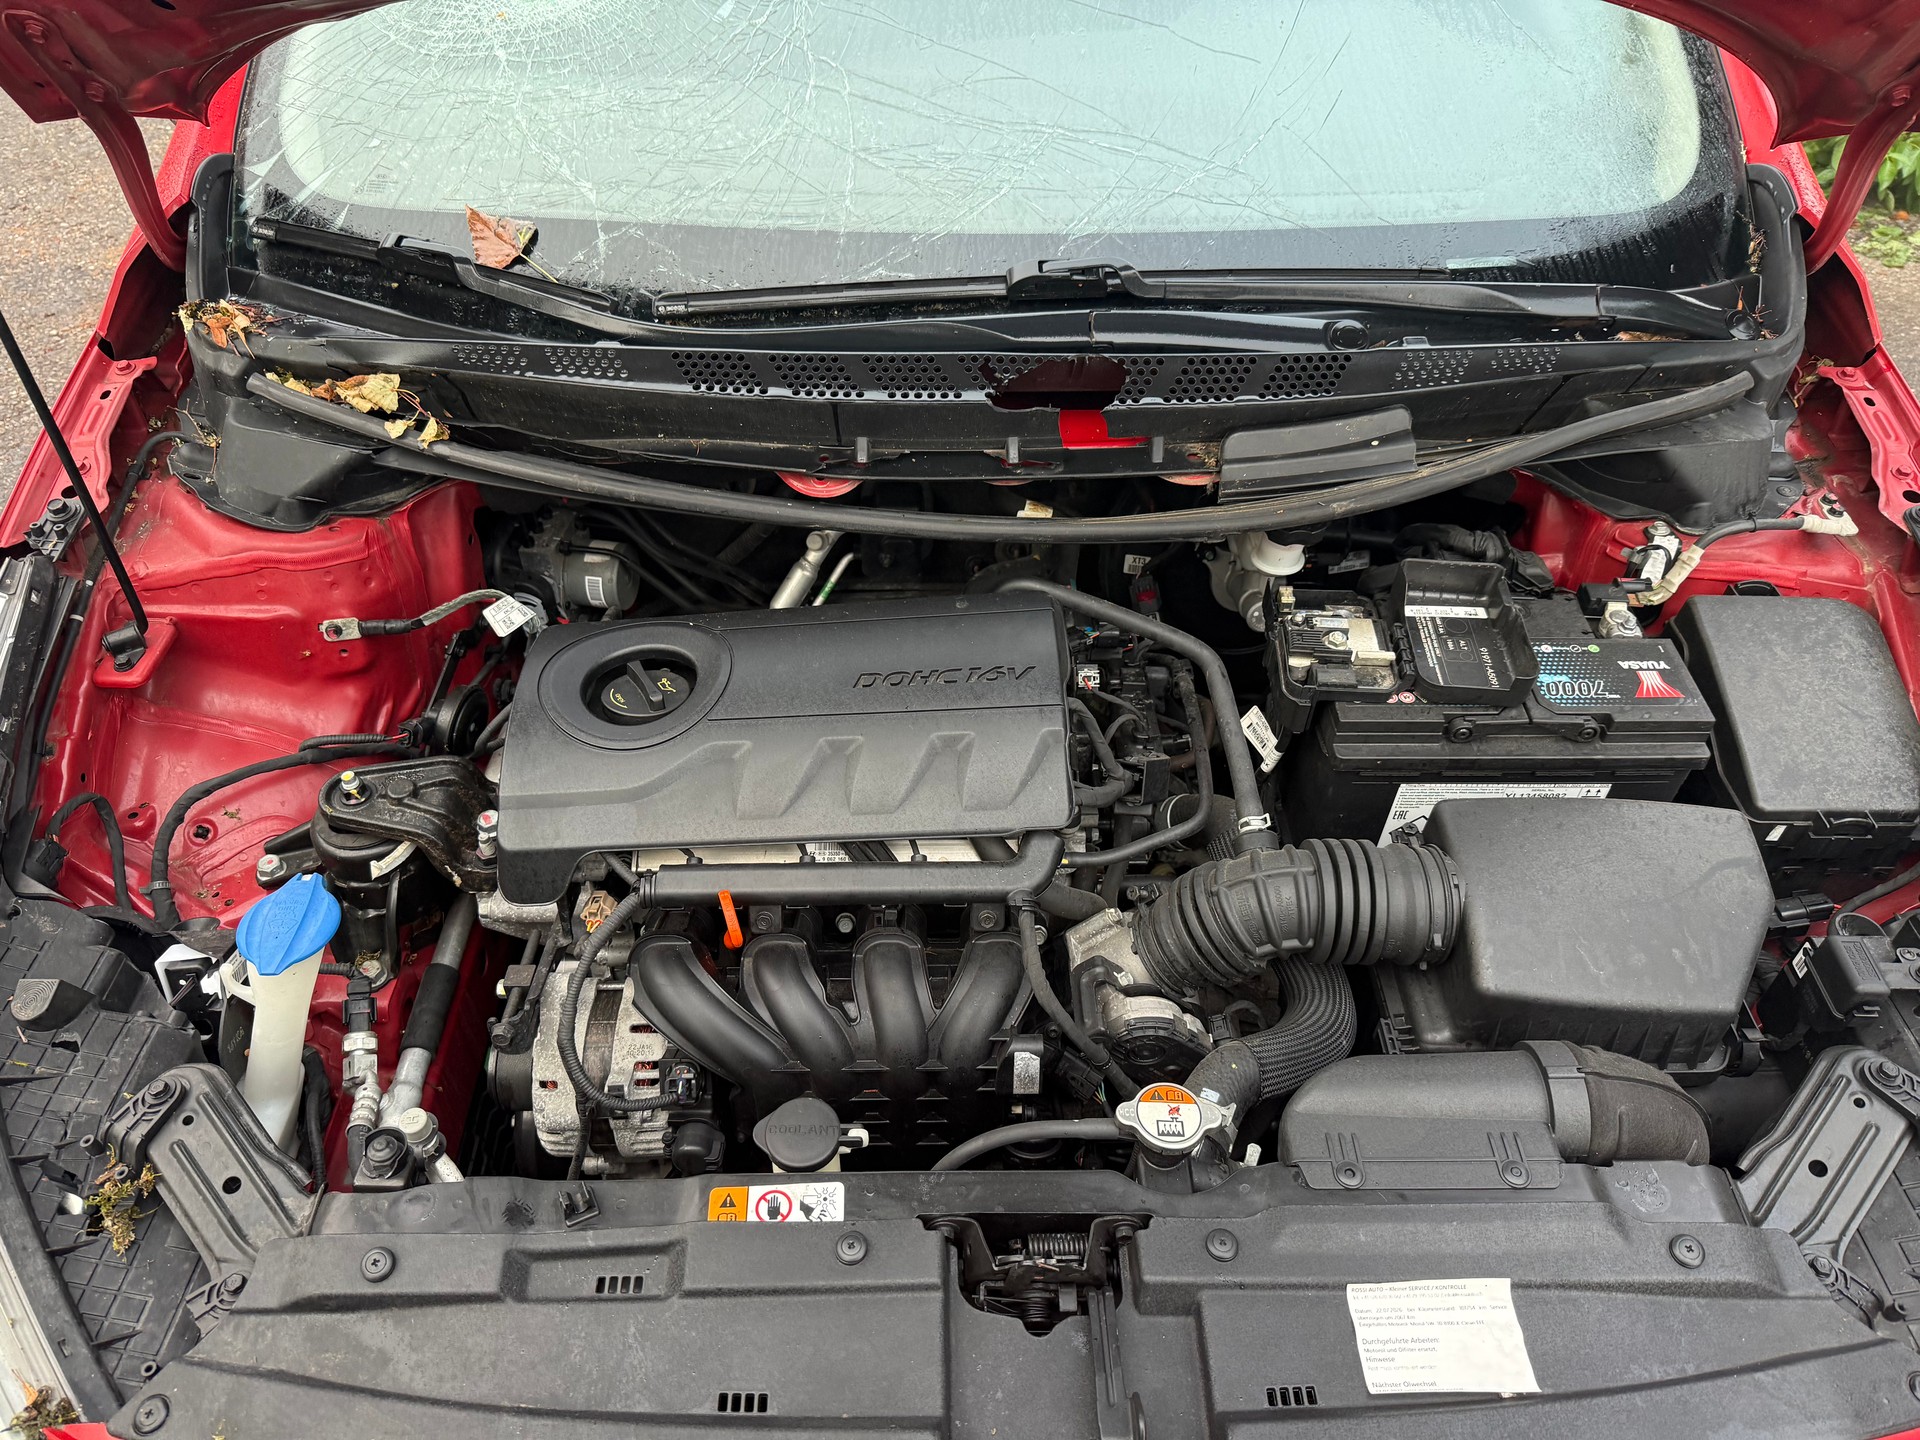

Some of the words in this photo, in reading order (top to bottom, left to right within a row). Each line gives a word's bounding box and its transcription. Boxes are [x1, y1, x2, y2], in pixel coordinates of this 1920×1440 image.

[1480, 647, 1500, 688] 91971-A5091
[1617, 660, 1671, 670] YUASA
[853, 667, 963, 689] DOHC
[965, 665, 1037, 685] 16V
[1545, 680, 1609, 698] 7000
[1392, 810, 1409, 820] EAC
[768, 1124, 840, 1136] COOLANT
